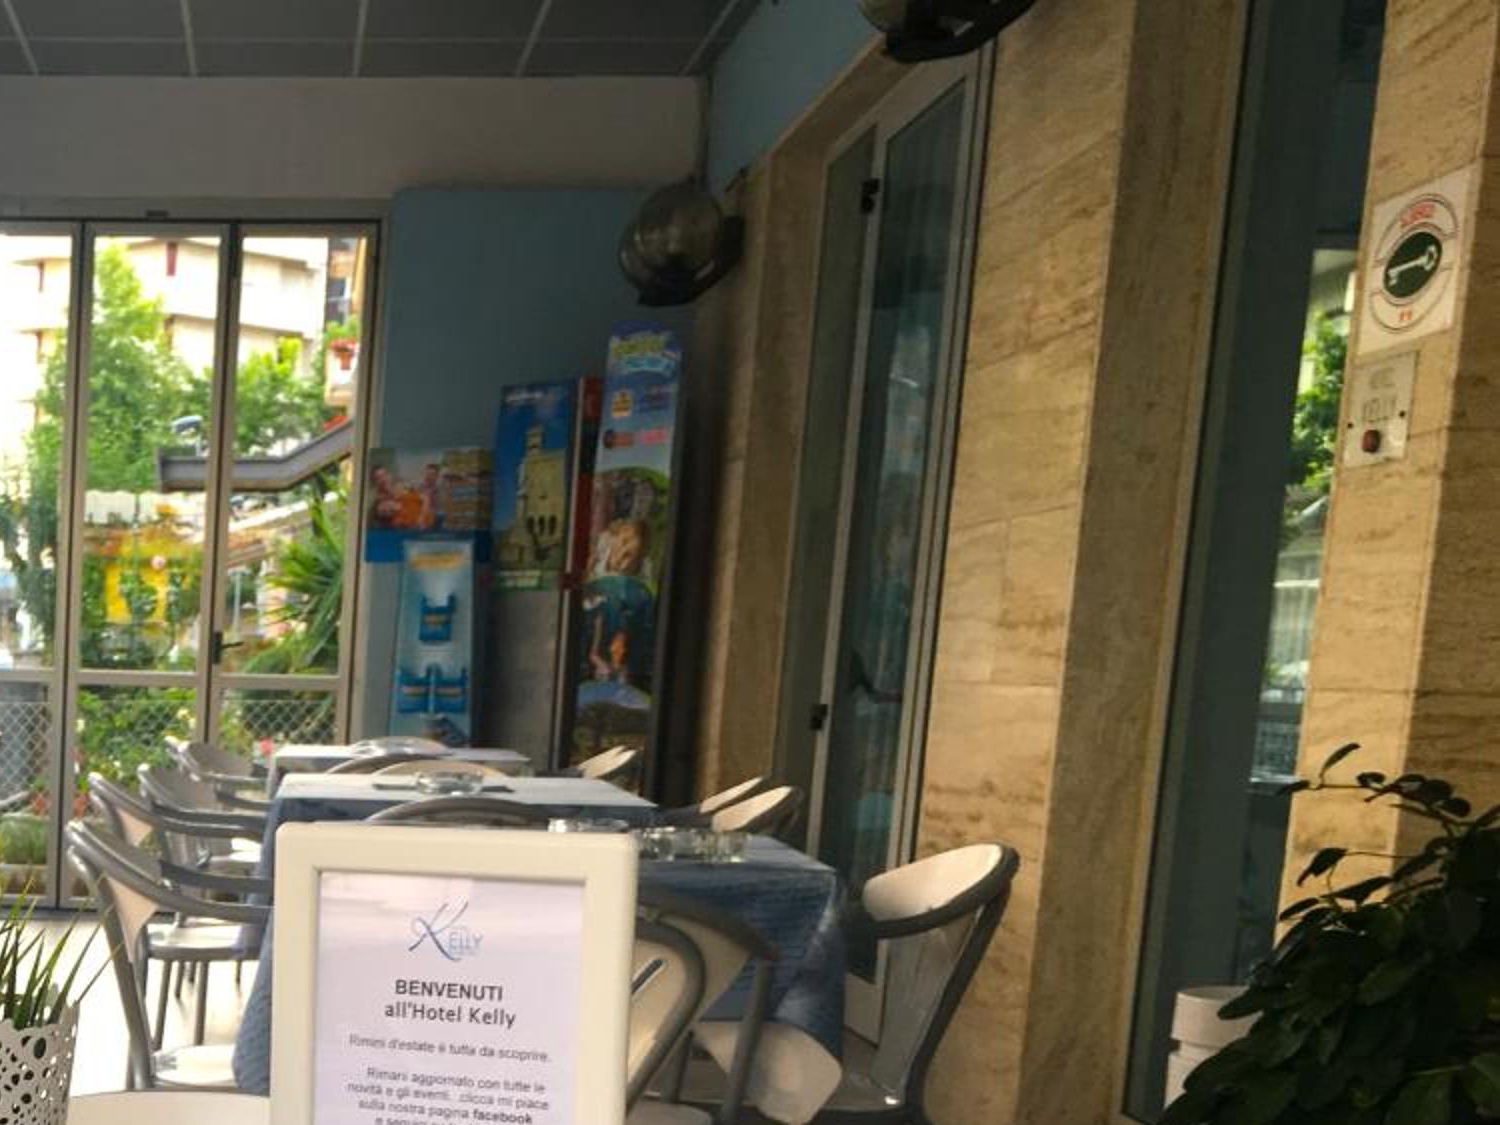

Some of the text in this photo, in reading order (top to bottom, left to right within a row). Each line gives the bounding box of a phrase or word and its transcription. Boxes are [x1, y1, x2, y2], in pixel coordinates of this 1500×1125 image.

[394, 979, 503, 1002] BENVENUTI
[384, 1001, 516, 1030] all'Hotel Kelly
[388, 1038, 435, 1053] d'estate
[449, 1043, 476, 1056] tutta
[479, 1045, 495, 1058] da
[411, 1072, 475, 1088] aggiornato
[477, 1078, 501, 1089] con
[503, 1078, 531, 1093] tutte
[386, 1087, 393, 1097] e
[515, 1095, 549, 1111] piace
[388, 1102, 425, 1115] nostra
[472, 1108, 533, 1125] facebook
